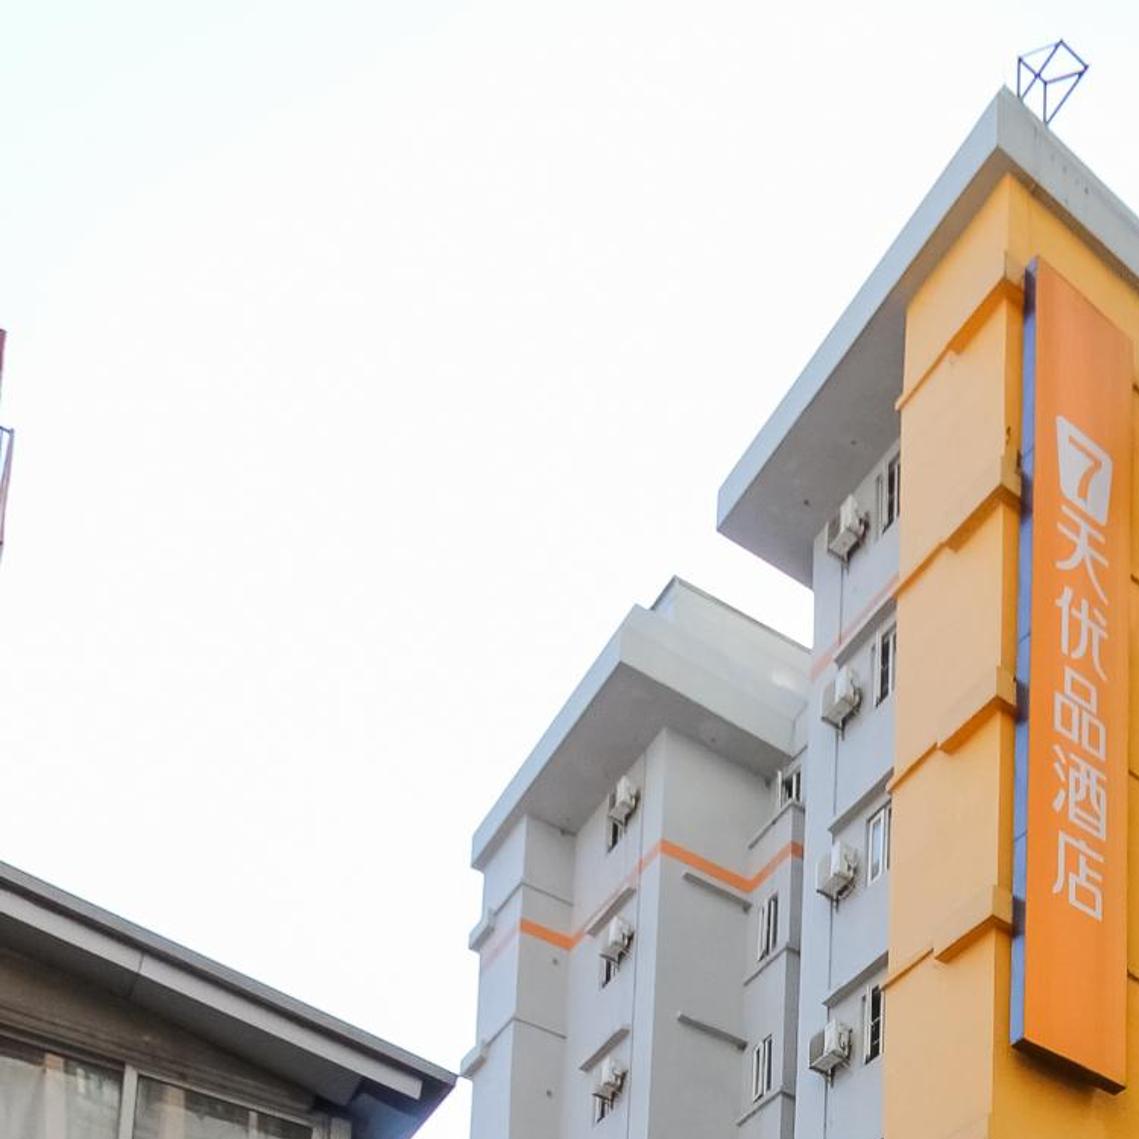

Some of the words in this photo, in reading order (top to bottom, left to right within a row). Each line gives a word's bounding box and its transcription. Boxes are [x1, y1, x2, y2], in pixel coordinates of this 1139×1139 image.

[1052, 415, 1113, 922] 7天优品酒店
